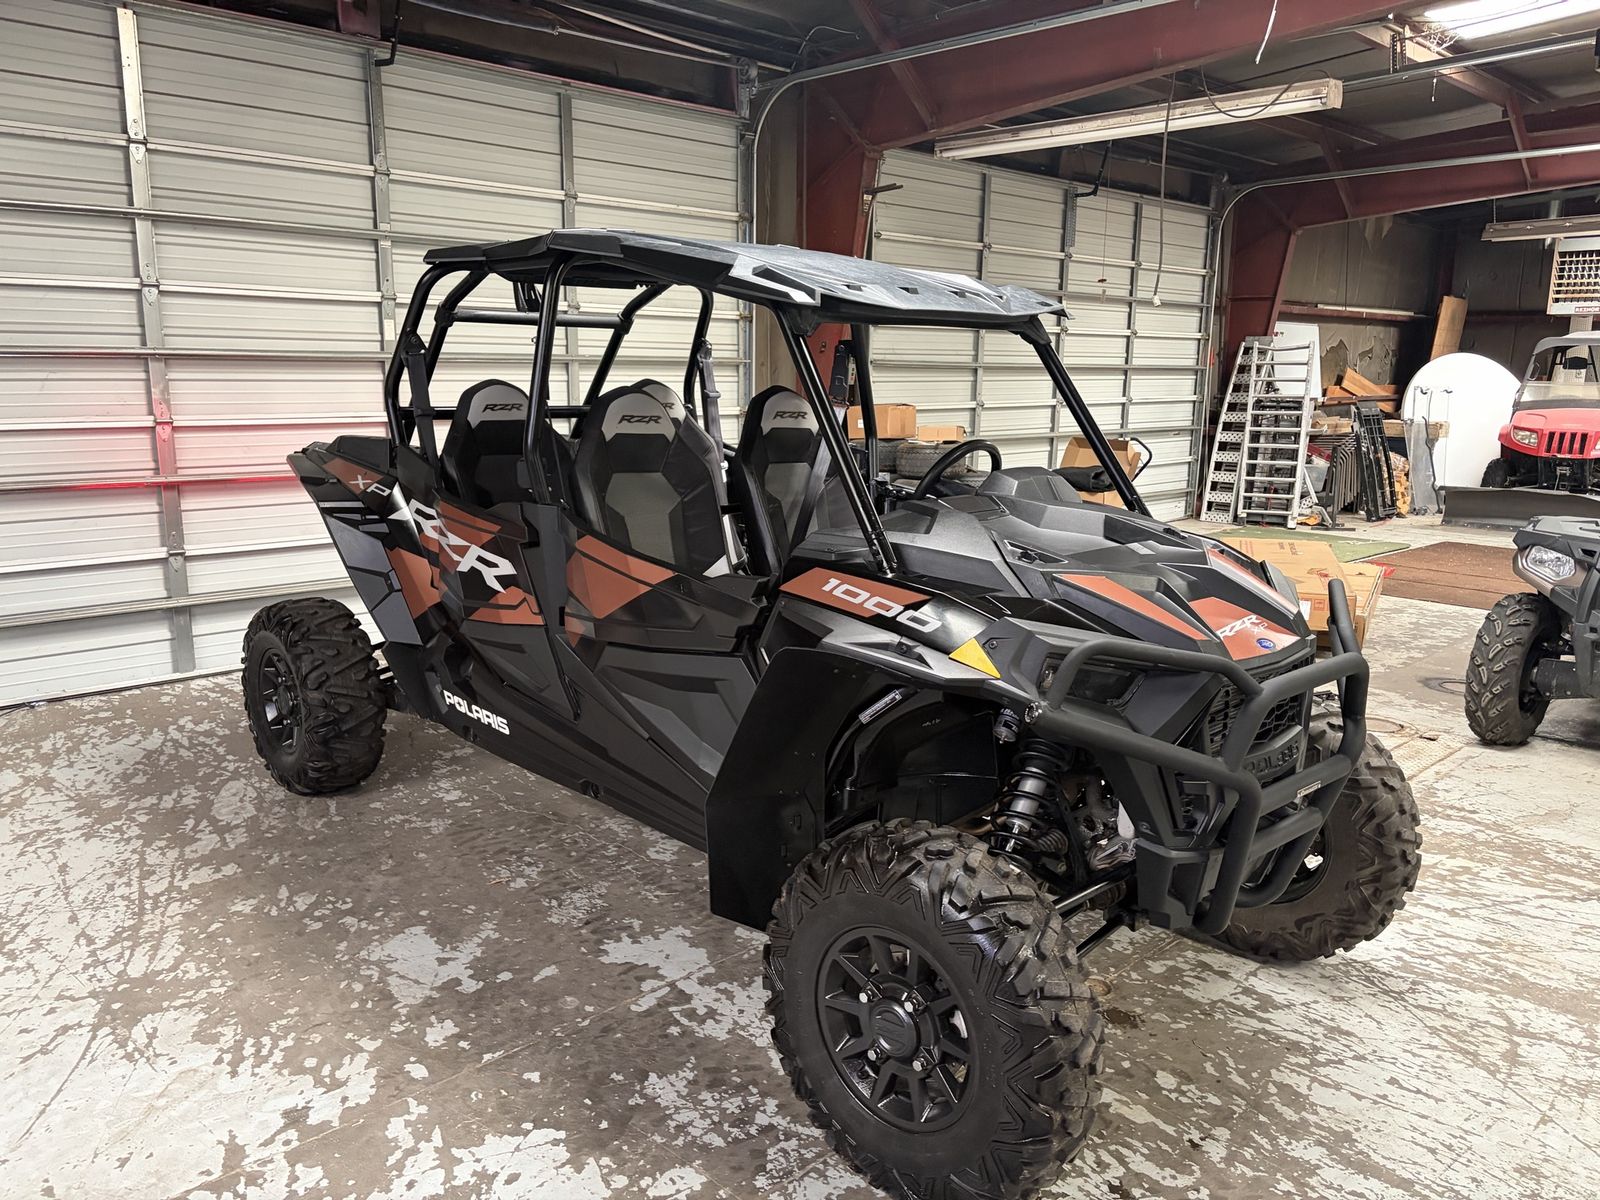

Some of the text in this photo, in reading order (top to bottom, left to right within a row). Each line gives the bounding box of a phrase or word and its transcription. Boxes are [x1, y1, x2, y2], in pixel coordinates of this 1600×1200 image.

[482, 403, 523, 413] RZR
[617, 414, 663, 425] RZR
[772, 410, 808, 420] RZR
[349, 474, 392, 497] XP
[821, 577, 943, 633] 1000
[1216, 614, 1263, 638] RZR
[443, 689, 511, 736] POLARIS
